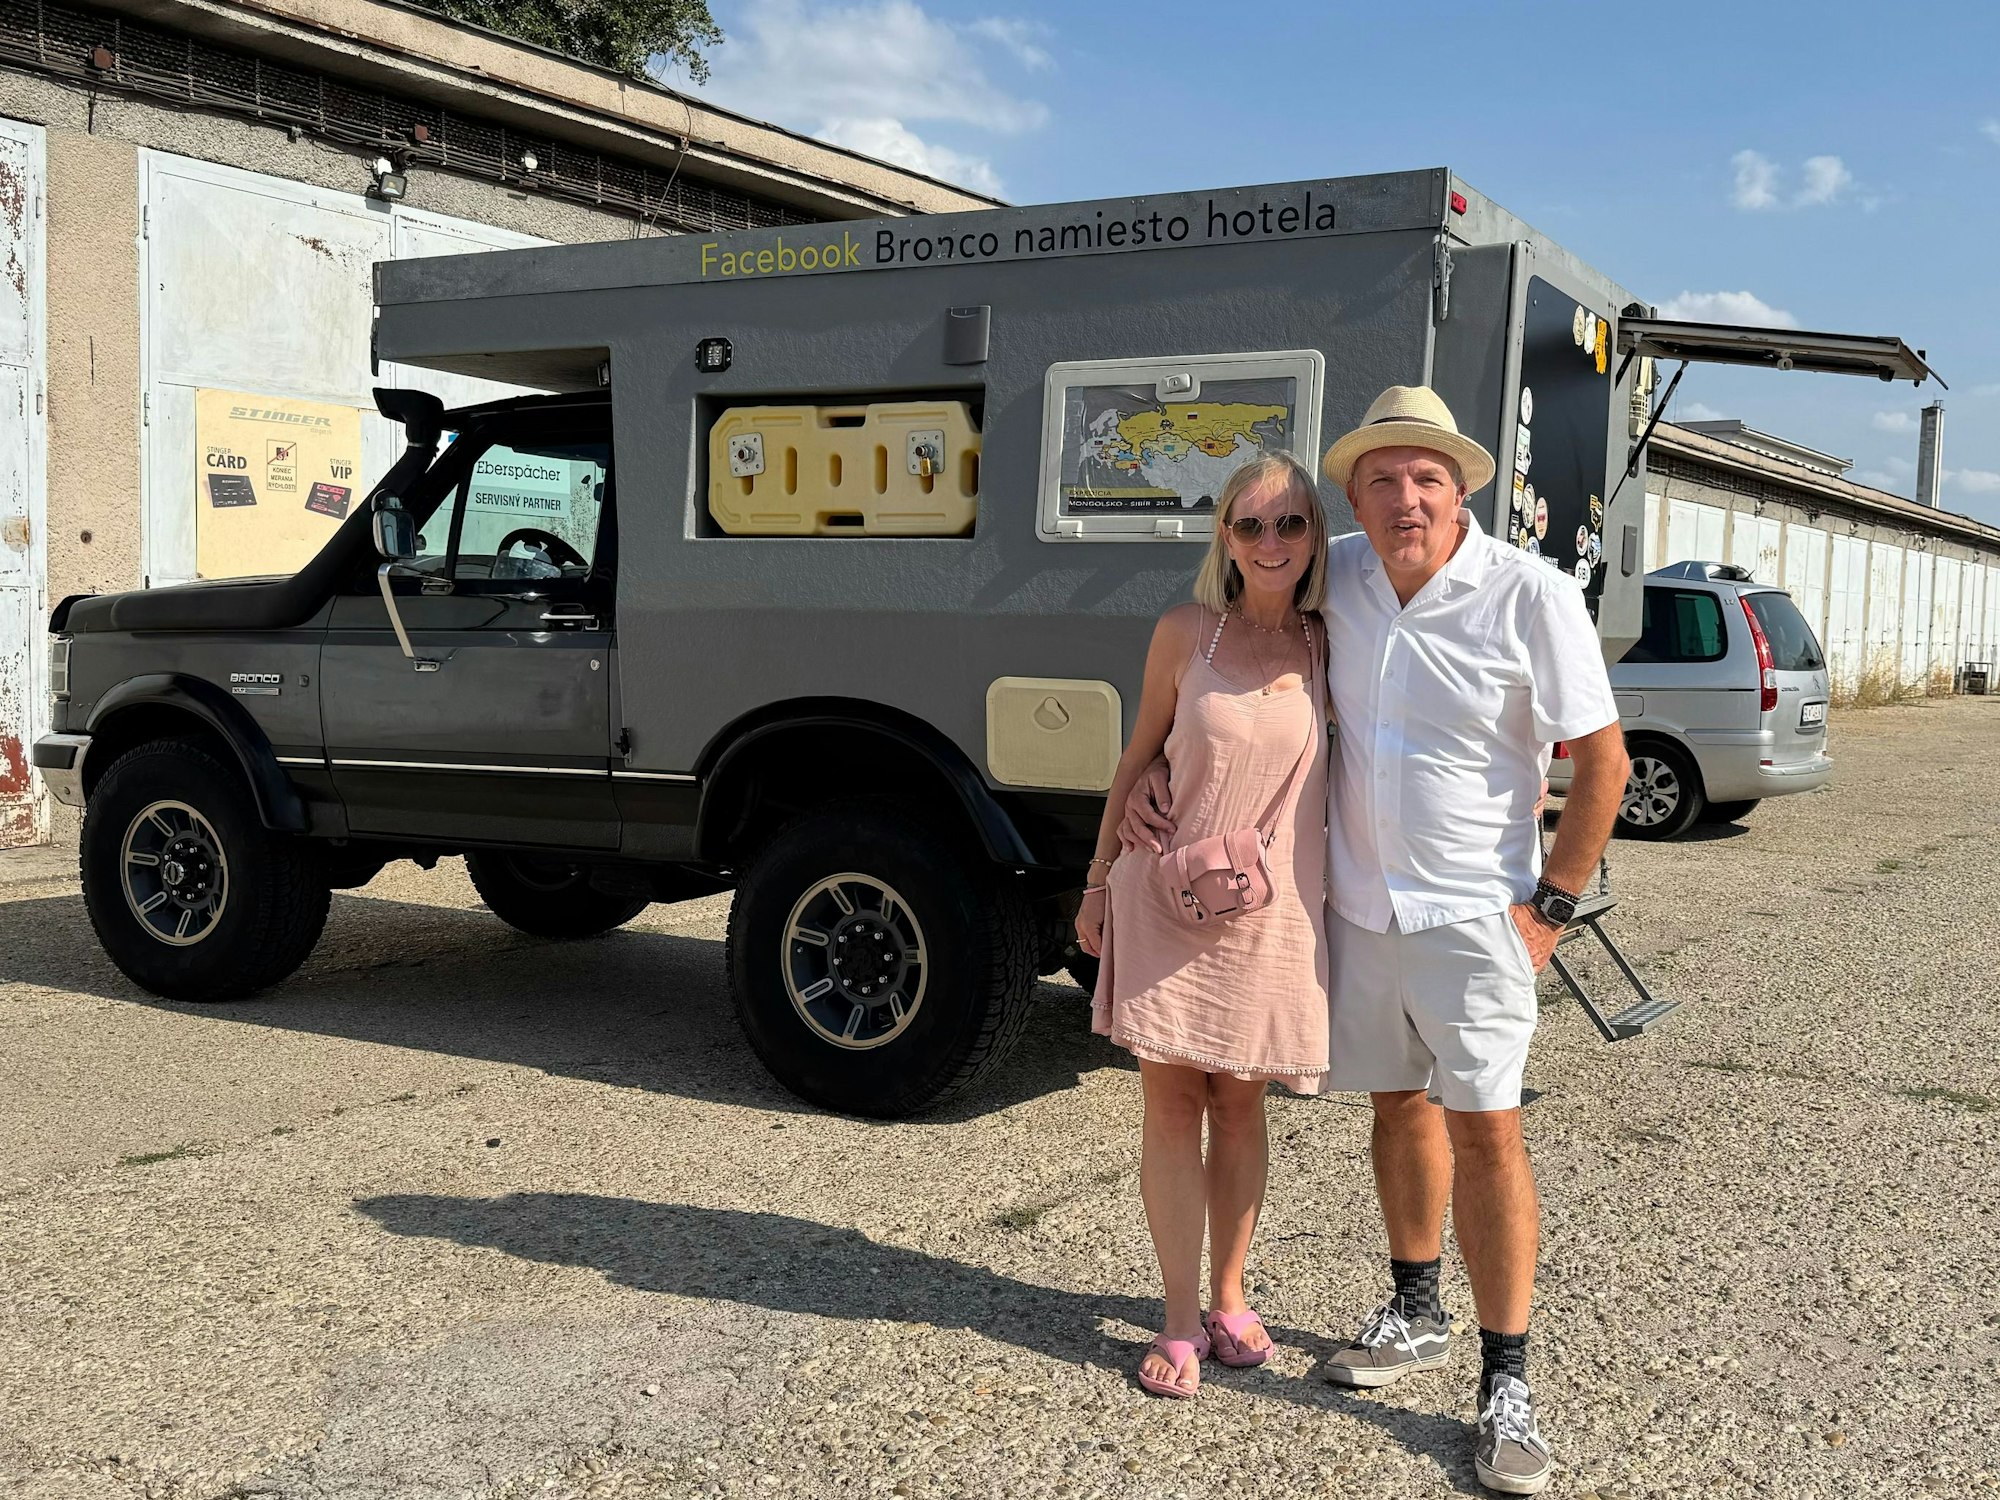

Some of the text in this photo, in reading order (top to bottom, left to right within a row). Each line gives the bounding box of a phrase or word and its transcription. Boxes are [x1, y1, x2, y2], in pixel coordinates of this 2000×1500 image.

[701, 191, 1336, 276] Facebook Bronco namiesto hotela
[229, 406, 332, 427] STINGER
[206, 445, 232, 454] STINGER
[206, 453, 248, 470] CARD
[330, 465, 353, 480] VIP
[476, 461, 561, 481] Eberspächer
[475, 492, 561, 511] SERVISNÝ PARTNER
[230, 673, 280, 683] BRONCO
